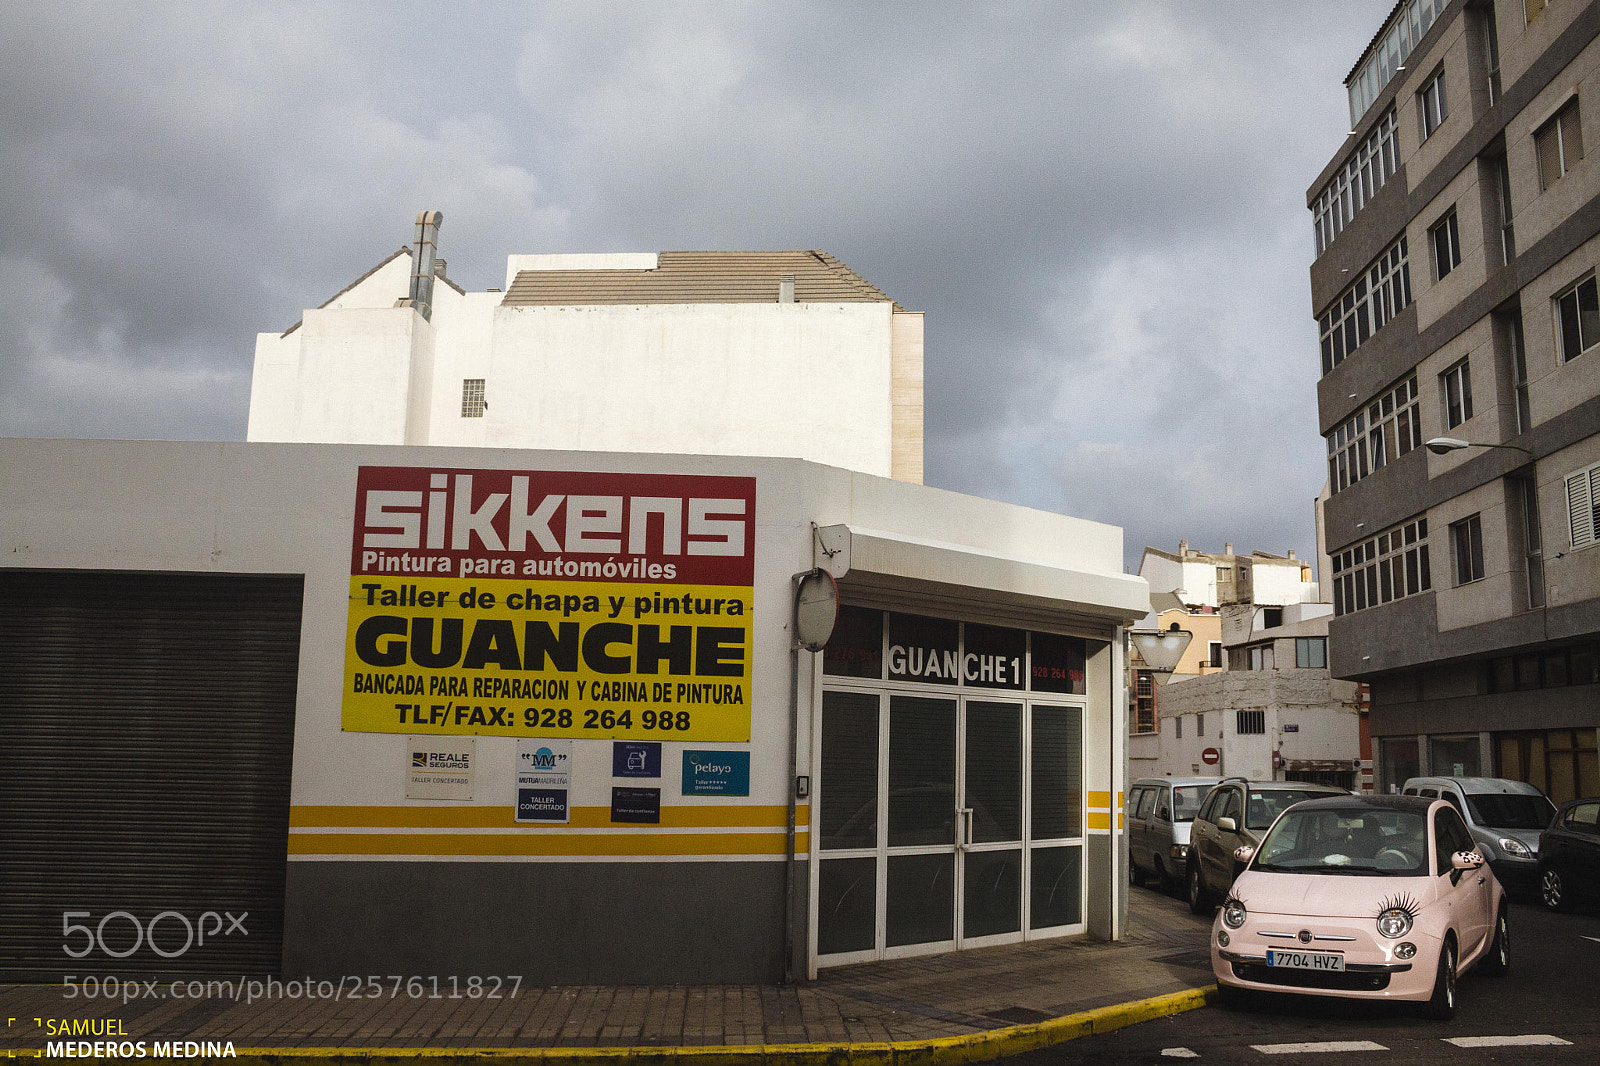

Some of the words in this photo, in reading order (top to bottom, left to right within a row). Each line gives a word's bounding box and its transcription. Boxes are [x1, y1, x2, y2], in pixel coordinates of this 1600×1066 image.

[363, 473, 746, 557] sikkens
[361, 551, 452, 573] Pintura
[460, 556, 516, 578] para
[523, 556, 677, 579] automóviles
[361, 583, 450, 608] Taller
[459, 586, 497, 609] de
[506, 588, 600, 617] chapa
[608, 595, 625, 618] y
[634, 591, 744, 618] pintura
[354, 614, 746, 678] GUANCHE
[888, 644, 1007, 684] GUANCHE
[1011, 657, 1020, 685] 1
[1032, 666, 1048, 678] 928
[1051, 667, 1066, 680] 264
[353, 672, 425, 697] BANCADA
[429, 676, 469, 698] PARA
[473, 677, 569, 701] REPARACION
[577, 680, 588, 701] Y
[591, 681, 648, 703] CABINA
[652, 682, 672, 703] DE
[676, 682, 744, 705] PINTURA
[395, 702, 515, 728] TLF/FAX:
[523, 708, 573, 728] 928
[583, 709, 633, 730] 264
[641, 710, 691, 731] 988
[429, 761, 469, 769] SEGUROS
[430, 752, 470, 762] REALE
[694, 762, 732, 775] pelayo
[432, 777, 469, 785] CONCERTADO
[520, 803, 565, 811] CONCERTADO
[530, 796, 555, 804] TALLER
[1277, 953, 1309, 968] 7704
[1313, 955, 1339, 970] HVZ
